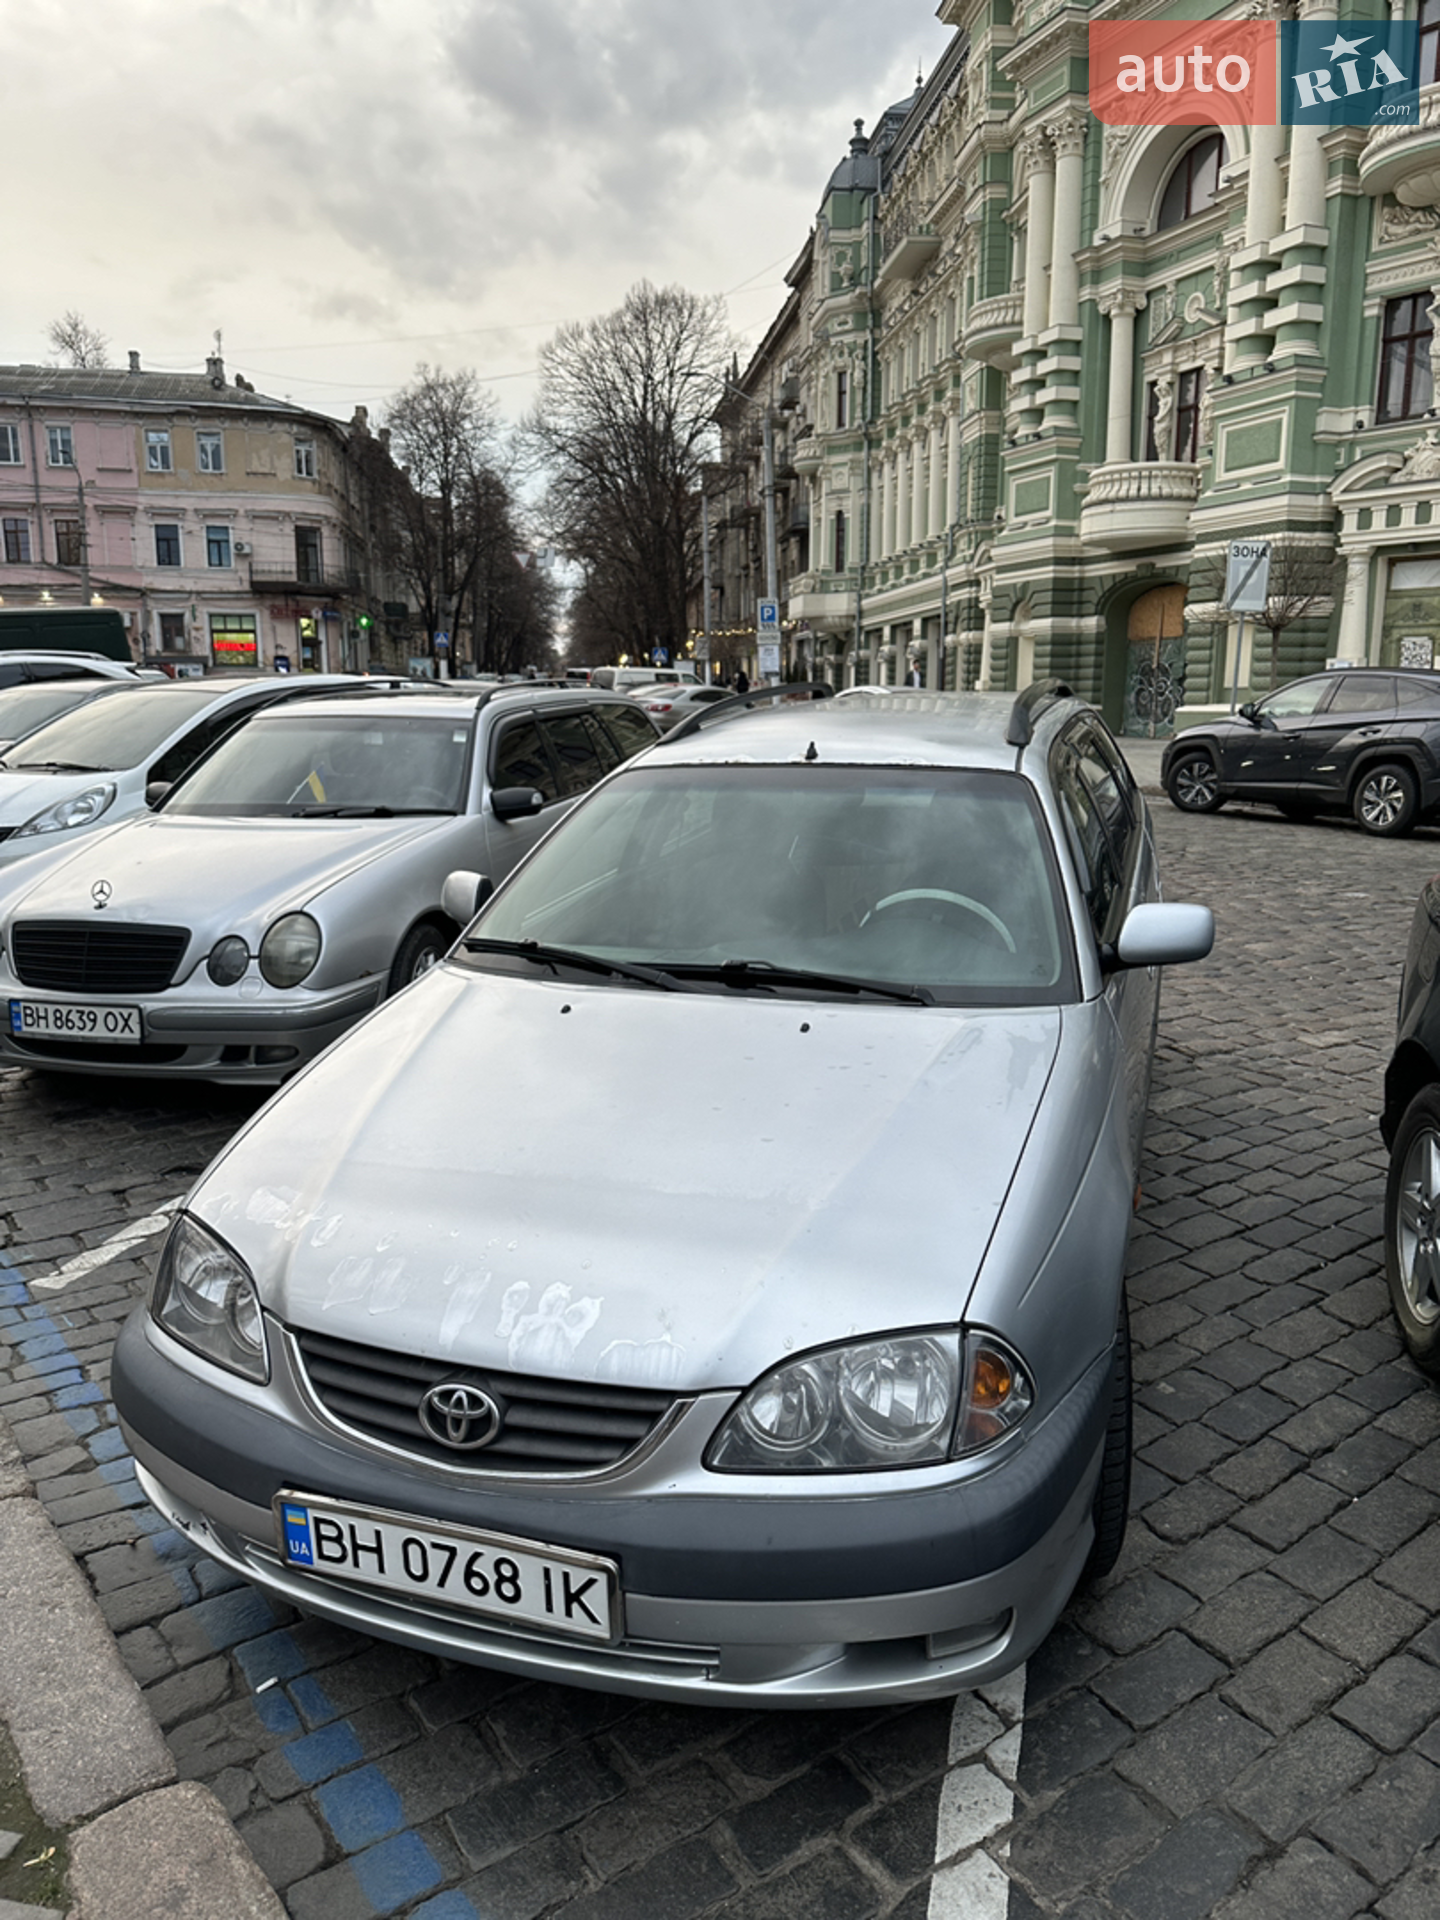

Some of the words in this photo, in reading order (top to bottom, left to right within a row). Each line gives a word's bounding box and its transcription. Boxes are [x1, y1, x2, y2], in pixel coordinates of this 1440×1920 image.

[1233, 546, 1267, 558] ЗОНА
[23, 1006, 48, 1029] BH
[53, 1009, 97, 1031] 8639
[104, 1012, 134, 1033] OX
[289, 1539, 310, 1557] UA
[313, 1516, 386, 1574] BH
[402, 1537, 522, 1604] 0768
[543, 1566, 601, 1625] IK
